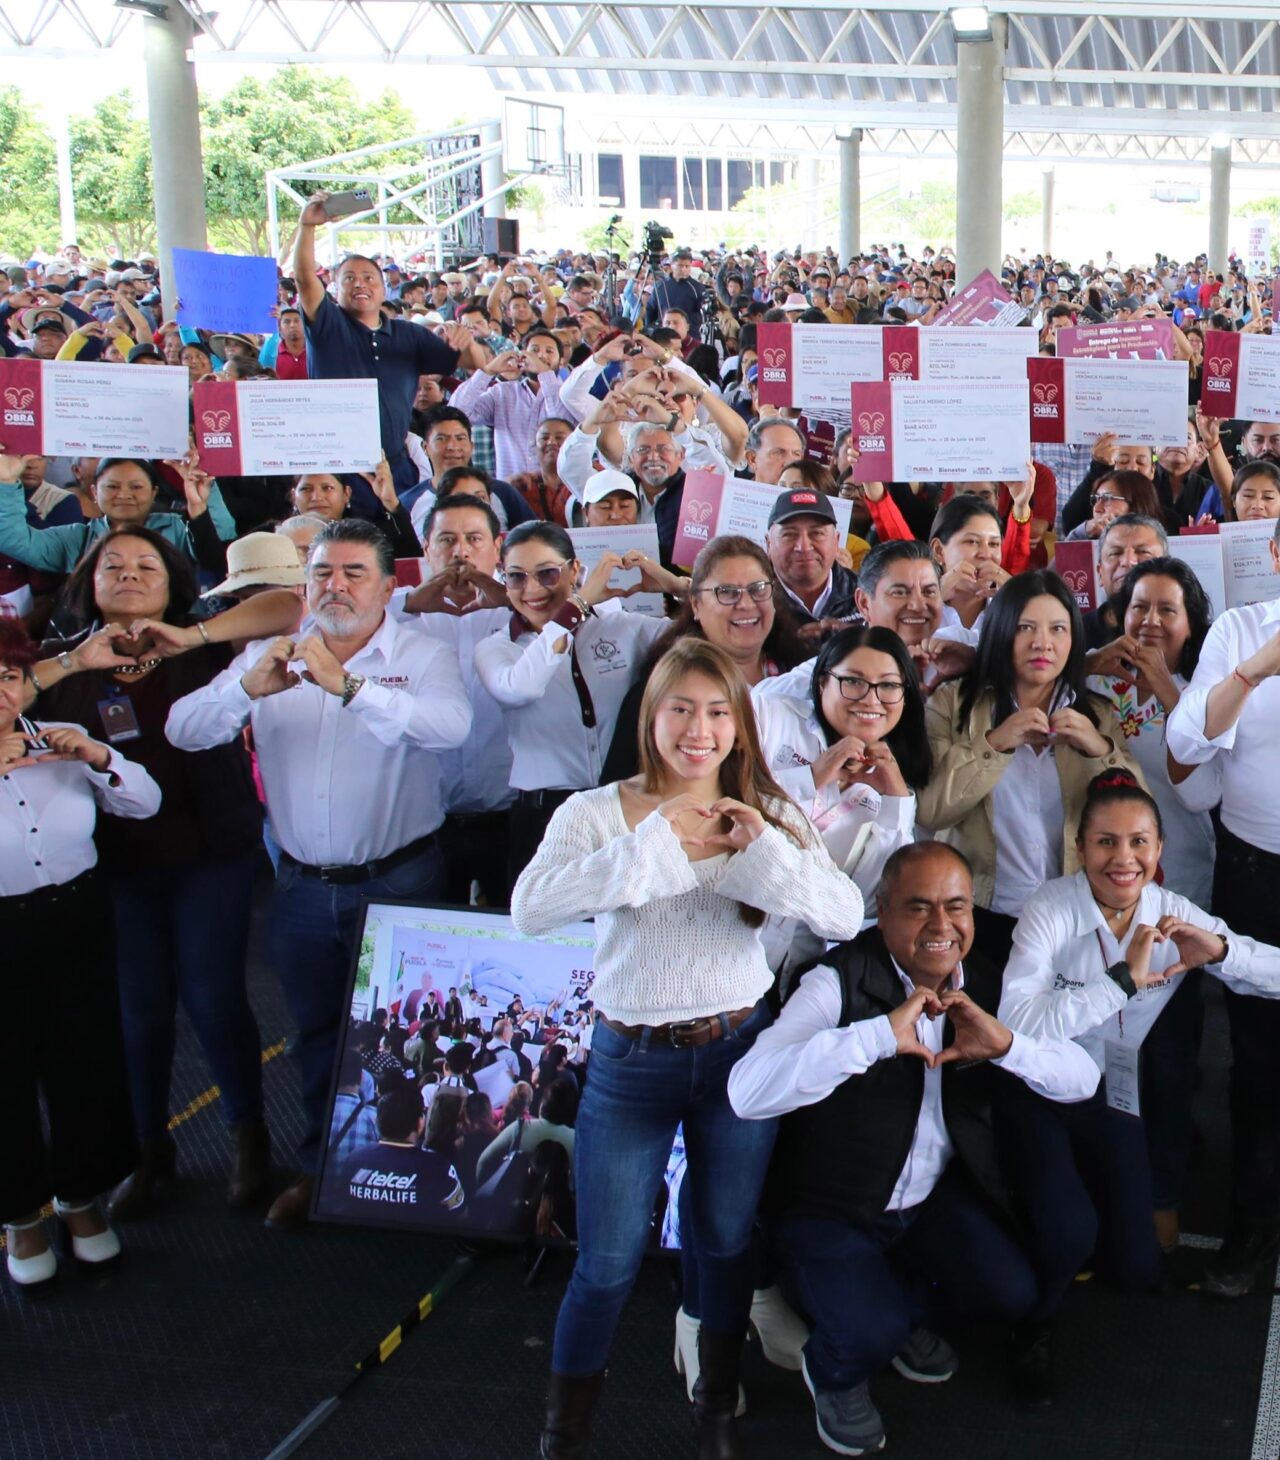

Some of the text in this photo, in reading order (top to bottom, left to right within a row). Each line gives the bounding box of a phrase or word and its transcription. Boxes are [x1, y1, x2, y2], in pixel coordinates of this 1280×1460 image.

[1089, 338, 1110, 346] Entrega
[1207, 381, 1230, 389] OBRA
[1033, 407, 1058, 415] OBRA
[4, 414, 34, 422] OBRA
[204, 436, 232, 444] OBRA
[859, 439, 885, 448] OBRA
[684, 526, 708, 538] OBRA
[380, 675, 408, 683] PUEBLA
[1056, 974, 1084, 988] Deporte
[1146, 979, 1170, 991] PUEBLA
[367, 1170, 417, 1189] telcel
[350, 1185, 416, 1203] HERBALIFE
